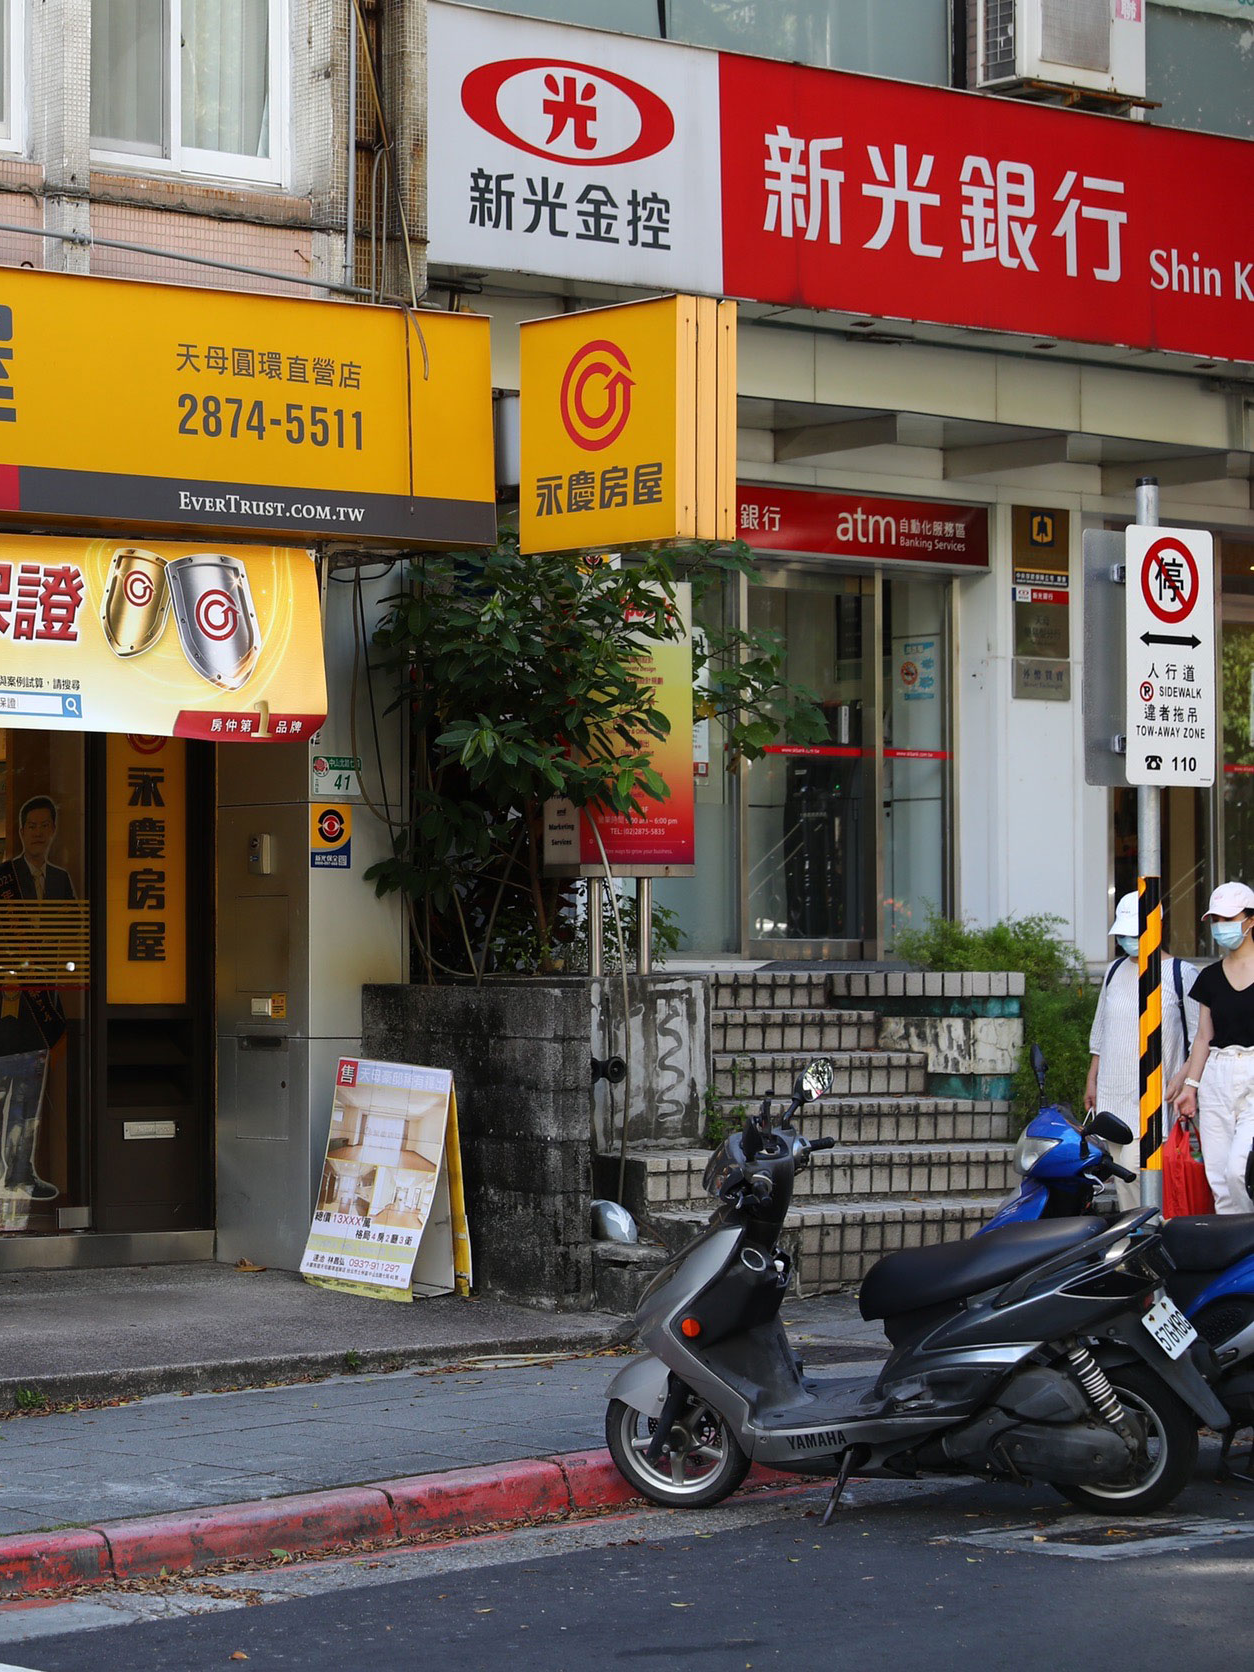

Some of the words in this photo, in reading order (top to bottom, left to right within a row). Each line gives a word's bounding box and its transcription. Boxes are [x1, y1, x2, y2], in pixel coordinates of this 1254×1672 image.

[542, 73, 597, 151] 光
[469, 167, 671, 251] 新光金控
[762, 125, 1128, 284] 新光銀行
[1149, 249, 1221, 298] Shin
[176, 342, 362, 391] 天母圓環直營店
[178, 393, 363, 451] 2874-5511
[536, 462, 662, 517] 永慶房屋
[740, 503, 780, 532] 銀行
[836, 506, 896, 545] atm
[899, 517, 966, 539] 自動化服務區
[899, 536, 933, 551] Banking
[934, 539, 966, 552] Services
[1154, 557, 1184, 603] 停
[1148, 663, 1195, 683] 人行道
[1159, 685, 1202, 699] SIDEWALK
[210, 701, 302, 739] 房仲第1品牌
[1144, 704, 1198, 723] 違者拖吊
[1136, 724, 1181, 739] TOW-AWAY
[1183, 726, 1205, 740] ZONE
[1171, 757, 1197, 772] 110
[334, 774, 350, 790] 41
[127, 767, 166, 962] 永慶房屋
[340, 1064, 355, 1084] 售
[314, 1211, 332, 1223] 總價
[362, 1217, 372, 1229] 萬
[355, 1230, 370, 1241] 格局
[349, 1258, 400, 1273] 0937-911297
[786, 1430, 846, 1451] YAMAHA
